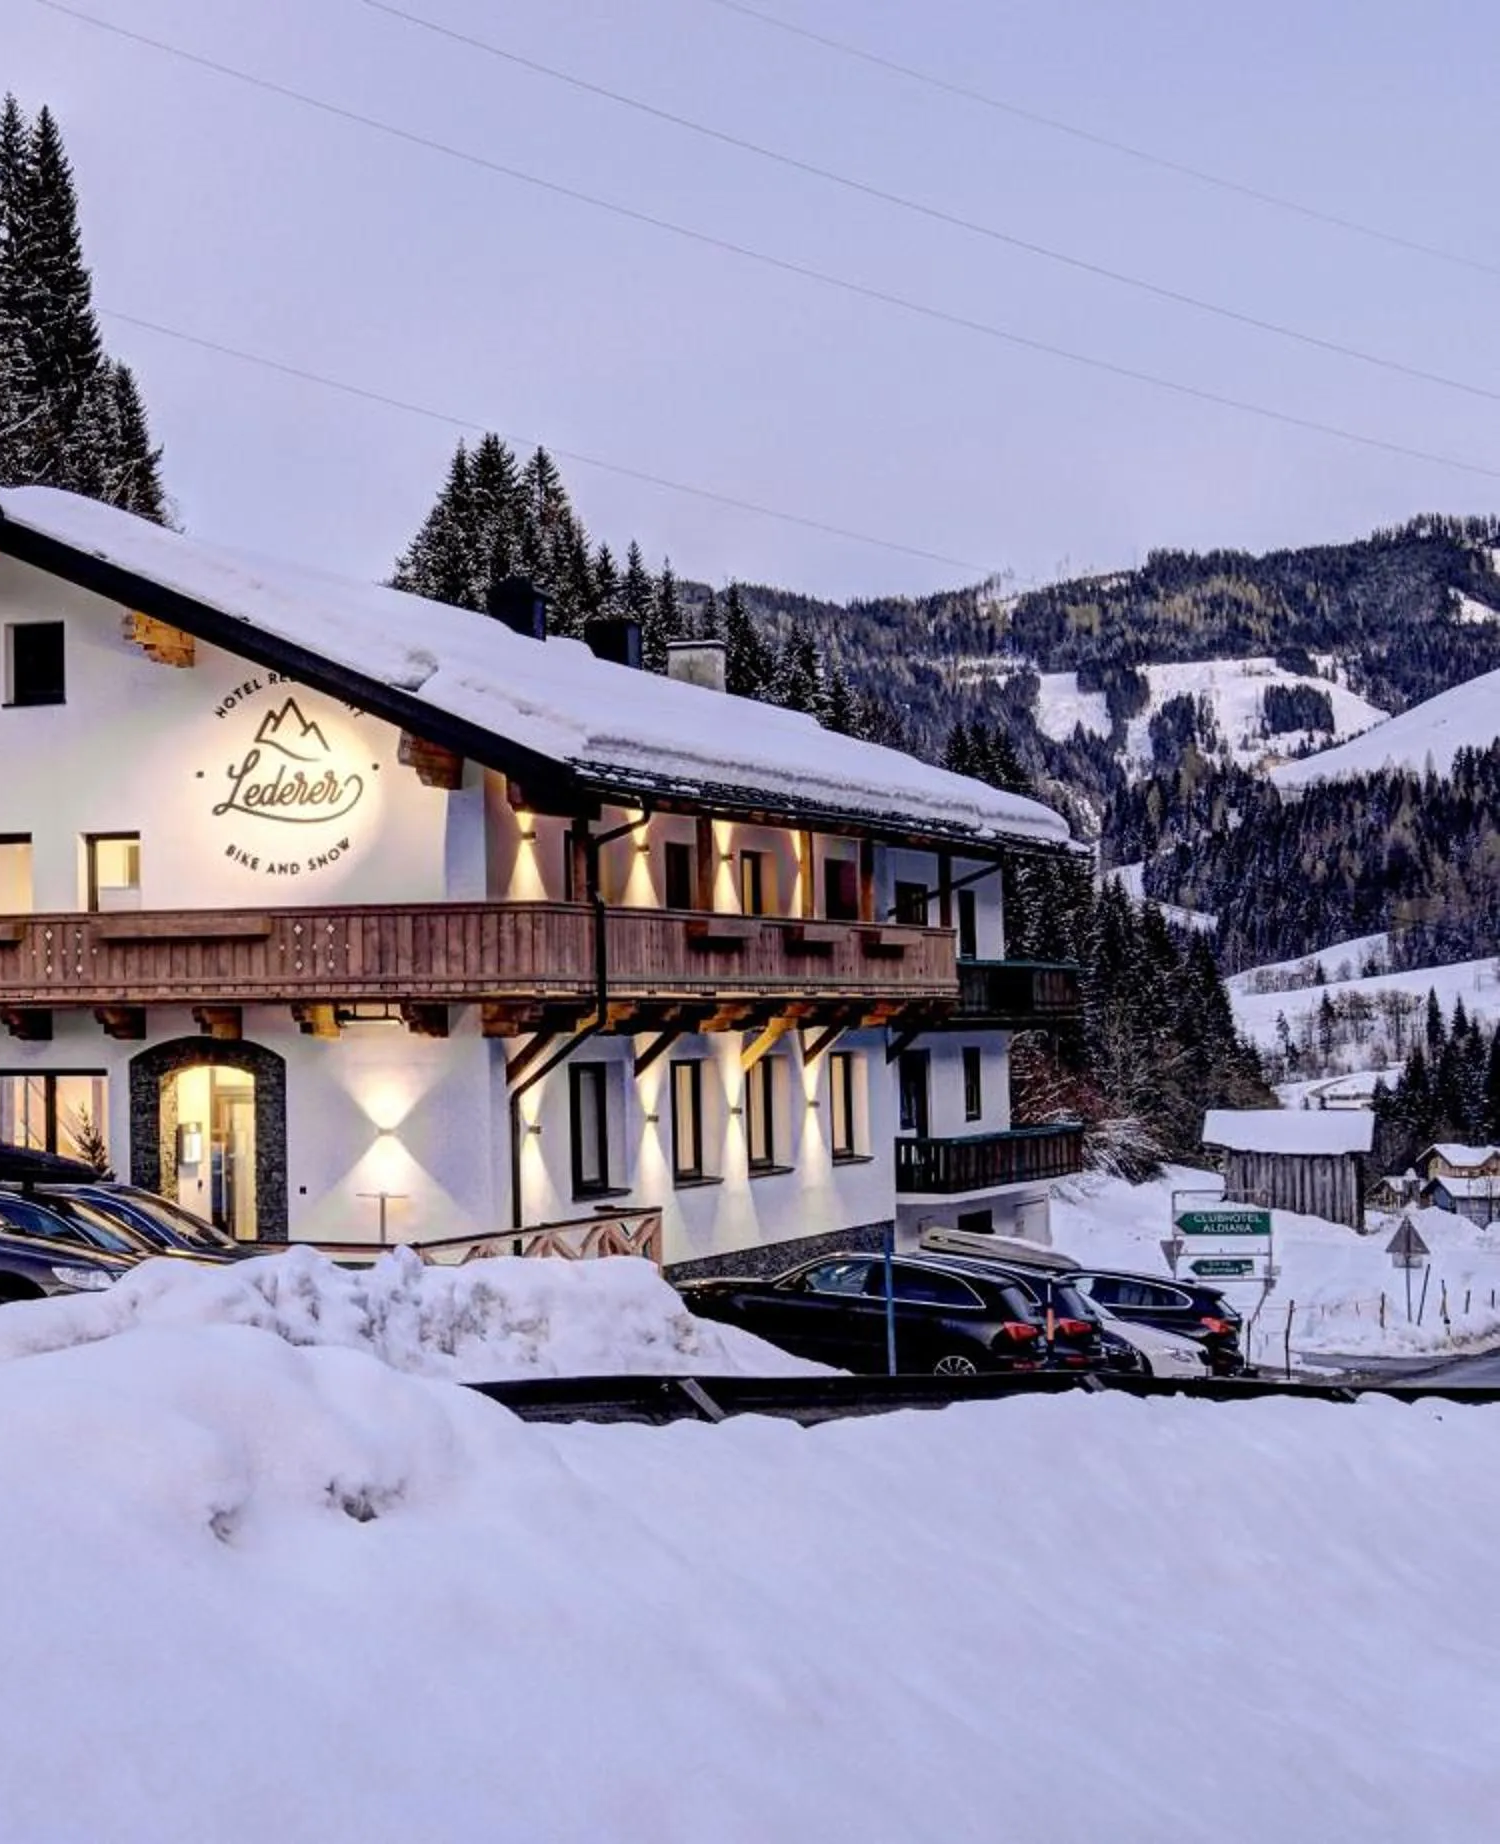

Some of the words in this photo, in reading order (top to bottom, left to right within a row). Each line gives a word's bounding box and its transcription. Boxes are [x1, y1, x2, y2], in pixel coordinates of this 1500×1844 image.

[214, 679, 263, 719] HOTEL
[212, 748, 364, 824] Lederer
[225, 844, 260, 872] BIKE
[266, 862, 301, 876] AND
[308, 837, 351, 871] SNOW
